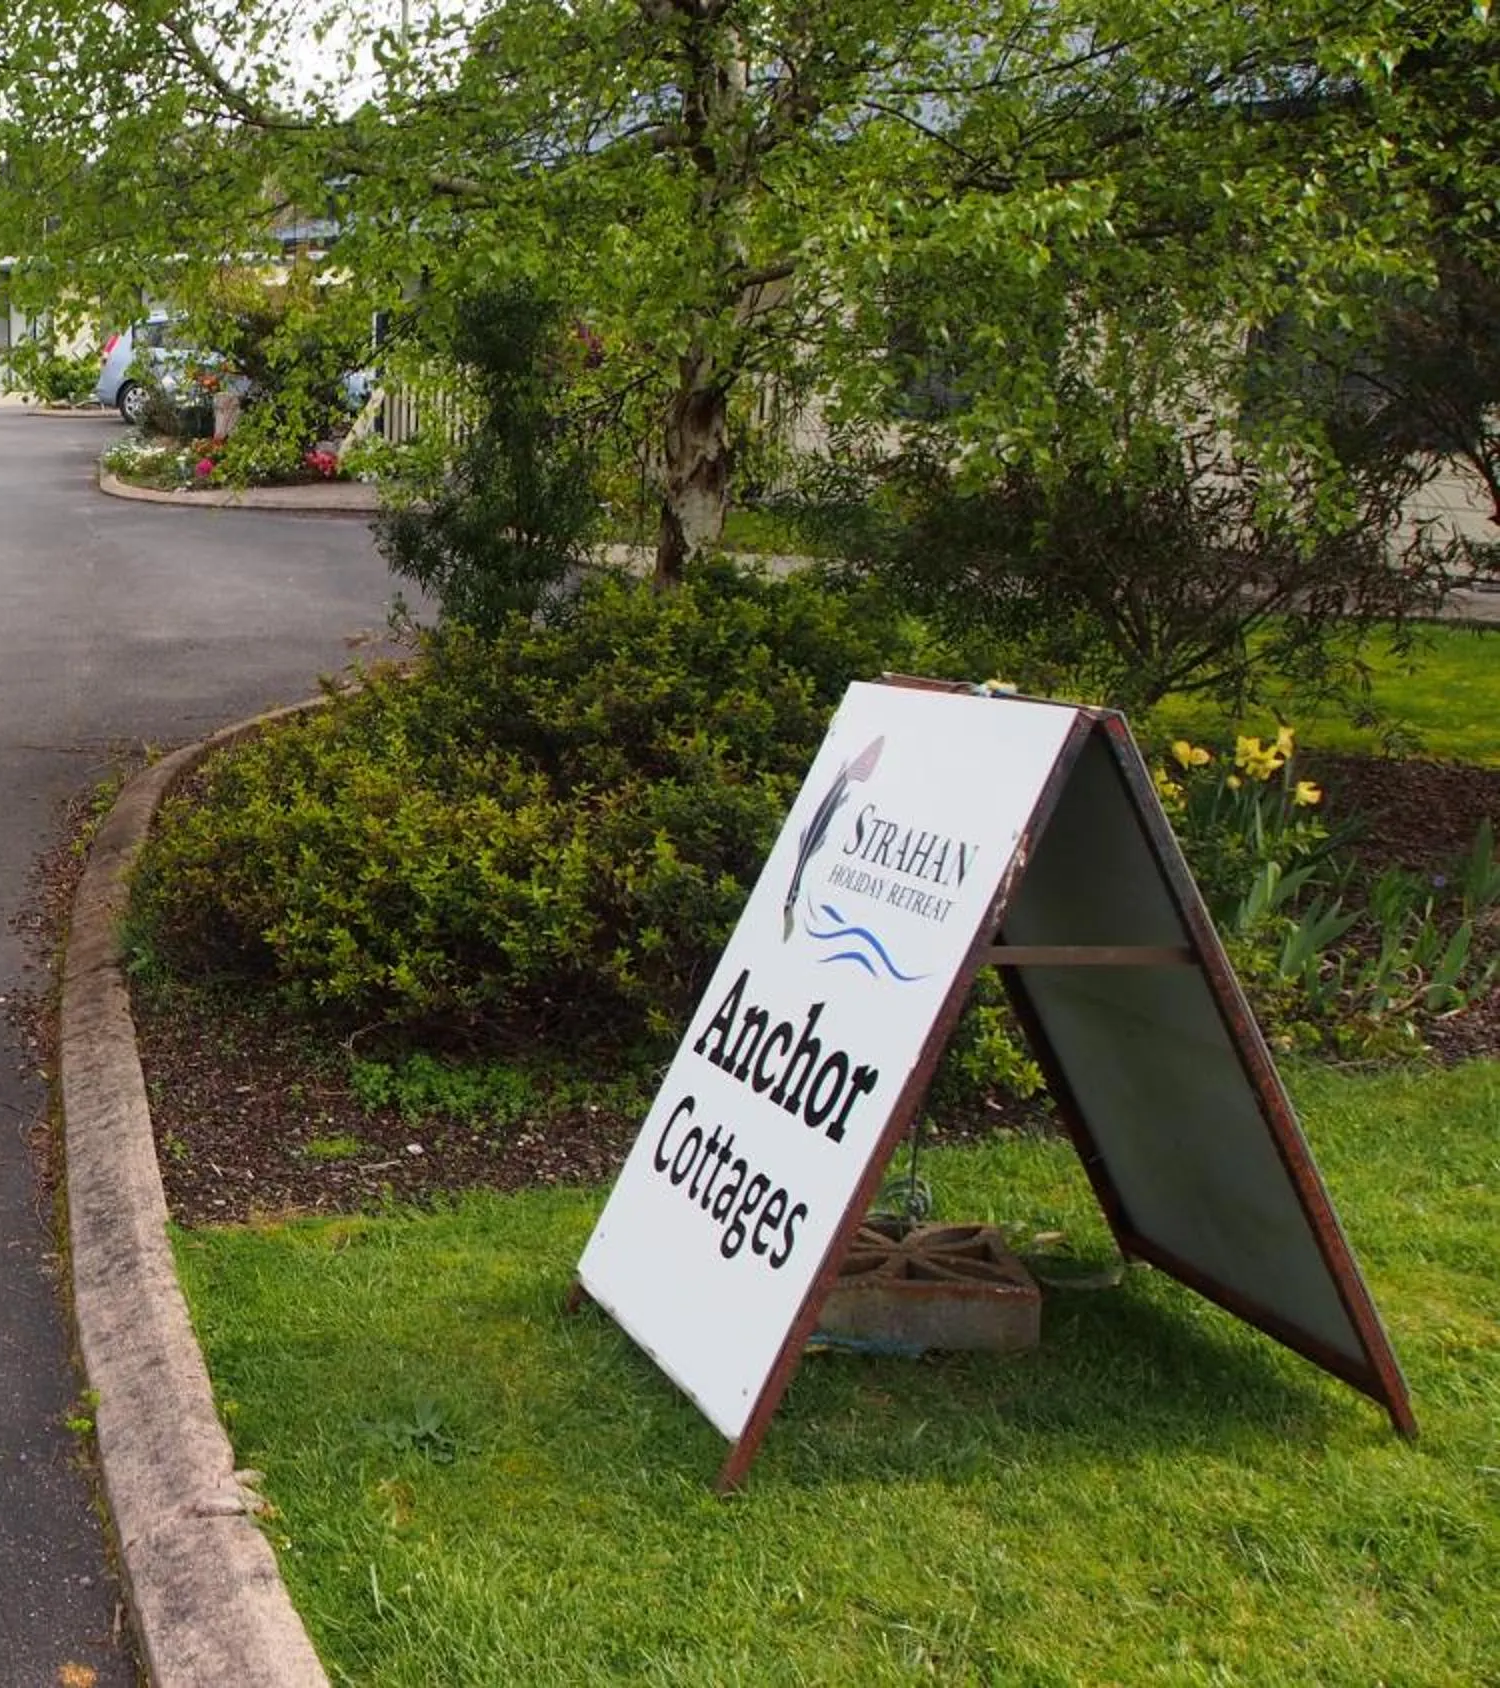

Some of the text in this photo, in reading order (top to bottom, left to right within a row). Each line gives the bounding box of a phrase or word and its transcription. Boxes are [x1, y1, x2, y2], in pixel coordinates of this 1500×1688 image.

[828, 863, 957, 922] HOLIDAY RETREAT
[843, 803, 980, 887] STRAHAN
[693, 969, 879, 1143] Anchor
[654, 1095, 808, 1269] Cottages
